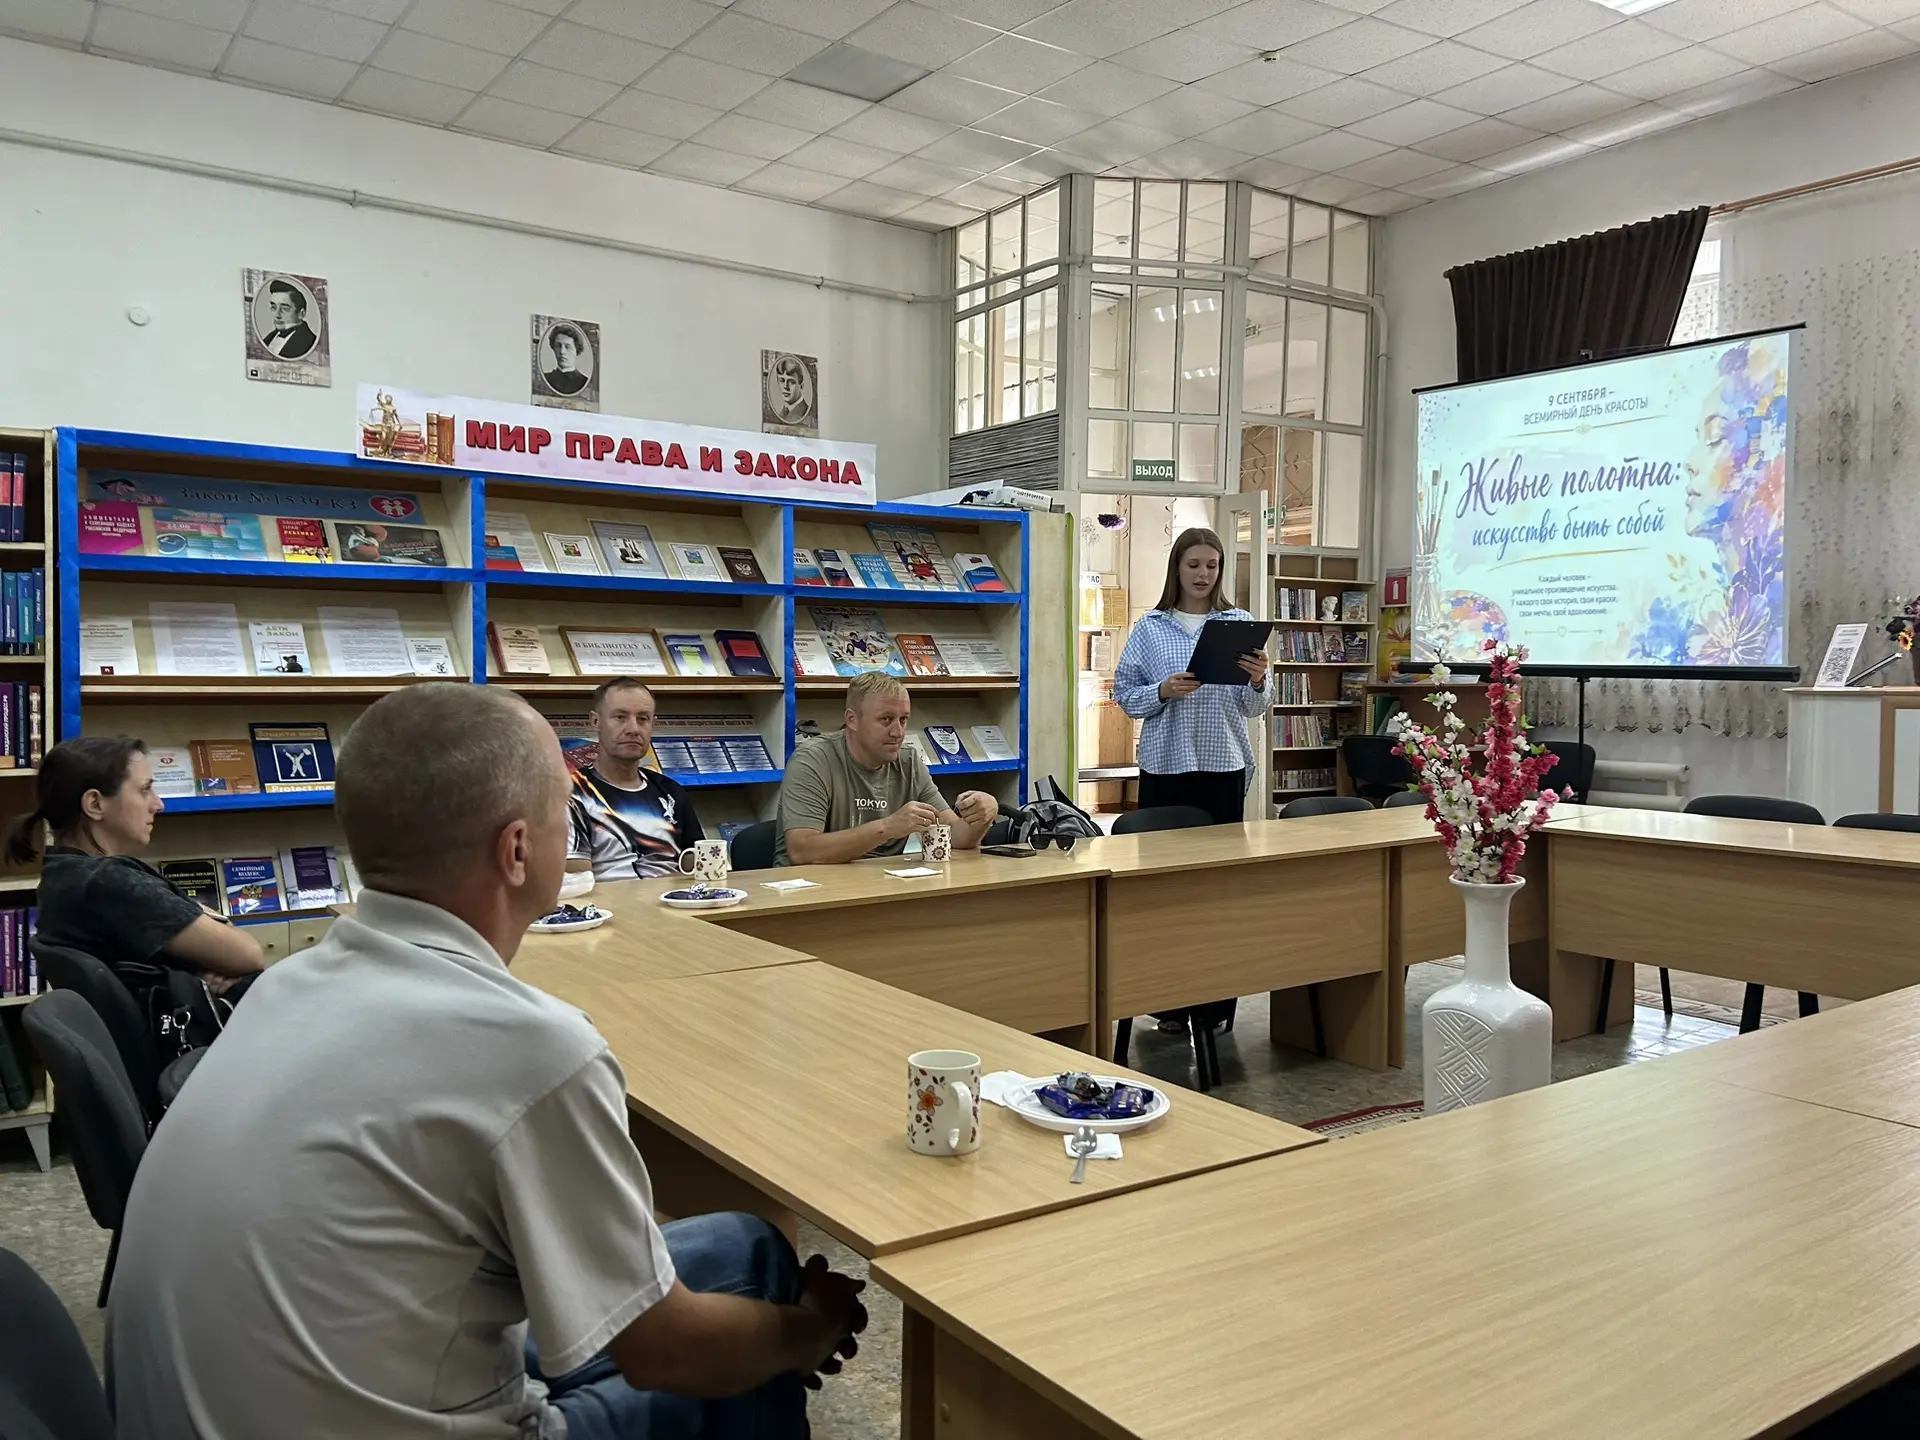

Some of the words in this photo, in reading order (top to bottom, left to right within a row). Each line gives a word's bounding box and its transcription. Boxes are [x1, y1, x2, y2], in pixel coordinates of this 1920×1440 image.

[1548, 395, 1555, 406] 9
[1556, 387, 1607, 406] СЕНТЯБРЯ
[1523, 405, 1578, 425] ВСЕМИРНЫЙ
[1578, 404, 1603, 419] ДЕНЬ
[1604, 397, 1649, 414] КРАСОТЫ
[465, 418, 552, 455] МИР
[564, 430, 689, 470] ПРАВА
[698, 445, 723, 473] И
[733, 449, 863, 486] ЗАКОНА
[1135, 464, 1174, 478] ВЫХОД
[178, 486, 240, 503] Закон
[1454, 453, 1553, 519] Живые
[1560, 455, 1682, 498] полотна:
[1472, 508, 1559, 561] искусство
[1562, 504, 1611, 541] быть
[1616, 499, 1666, 536] собой
[582, 642, 639, 650] БИБЛИОТЕКУ
[854, 798, 888, 809] TOKYO
